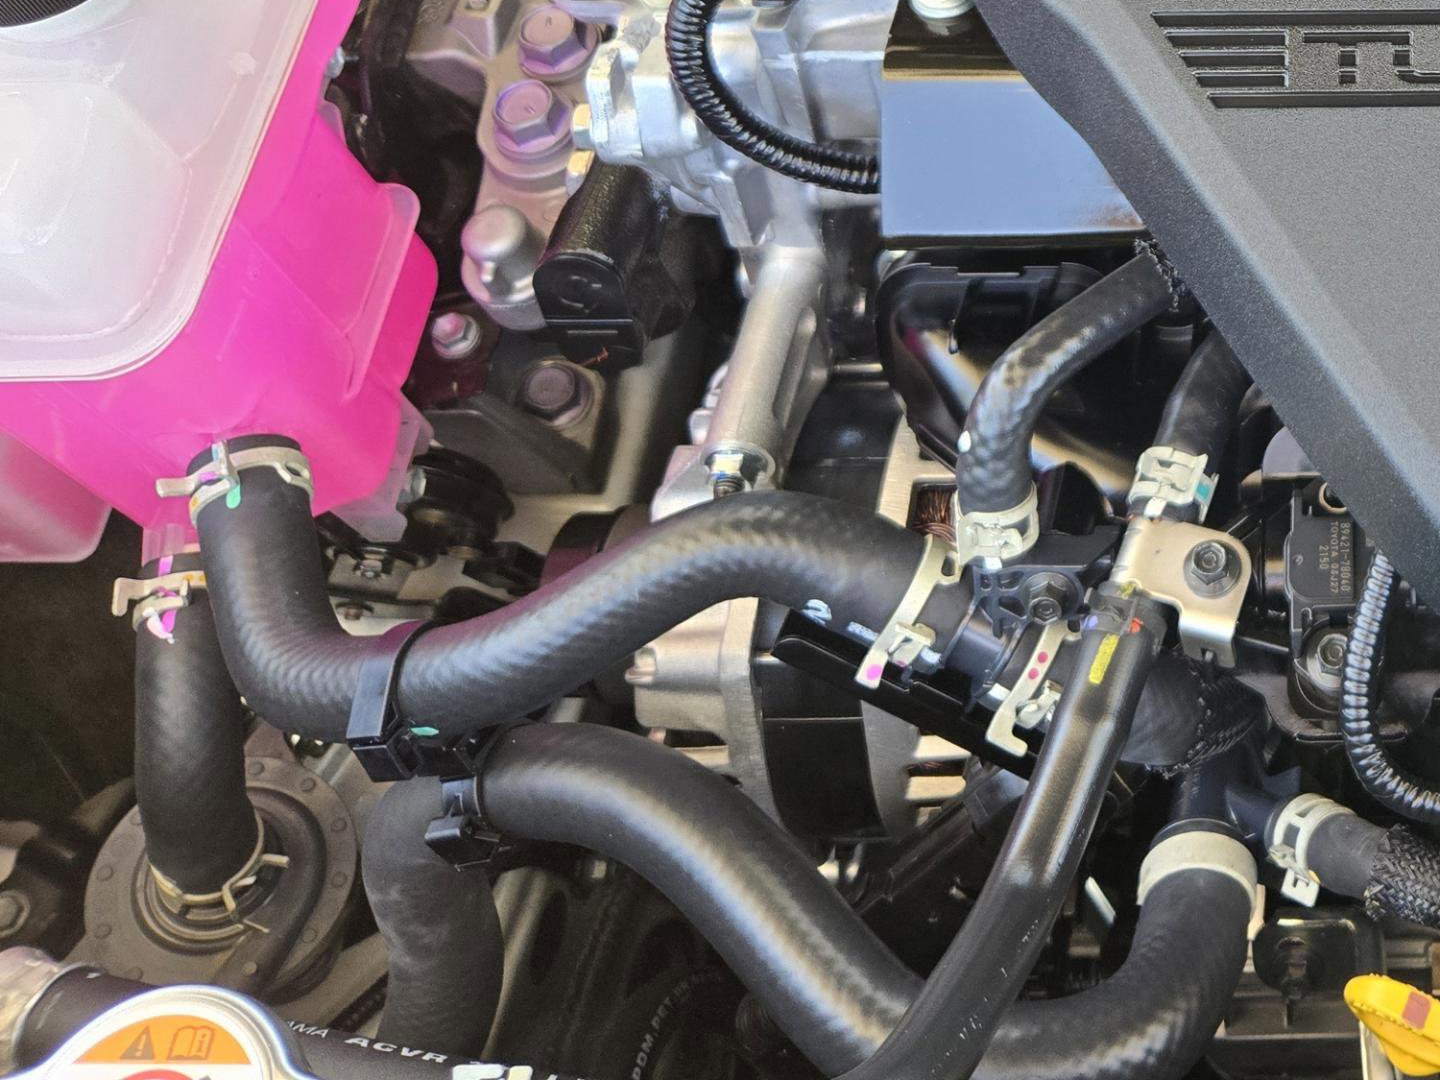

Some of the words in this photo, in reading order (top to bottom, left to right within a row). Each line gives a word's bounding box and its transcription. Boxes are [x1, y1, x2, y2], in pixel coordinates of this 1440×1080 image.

[1330, 521, 1340, 558] TOYOTA
[1318, 544, 1330, 570] 2150
[344, 1036, 449, 1064] ACVR
